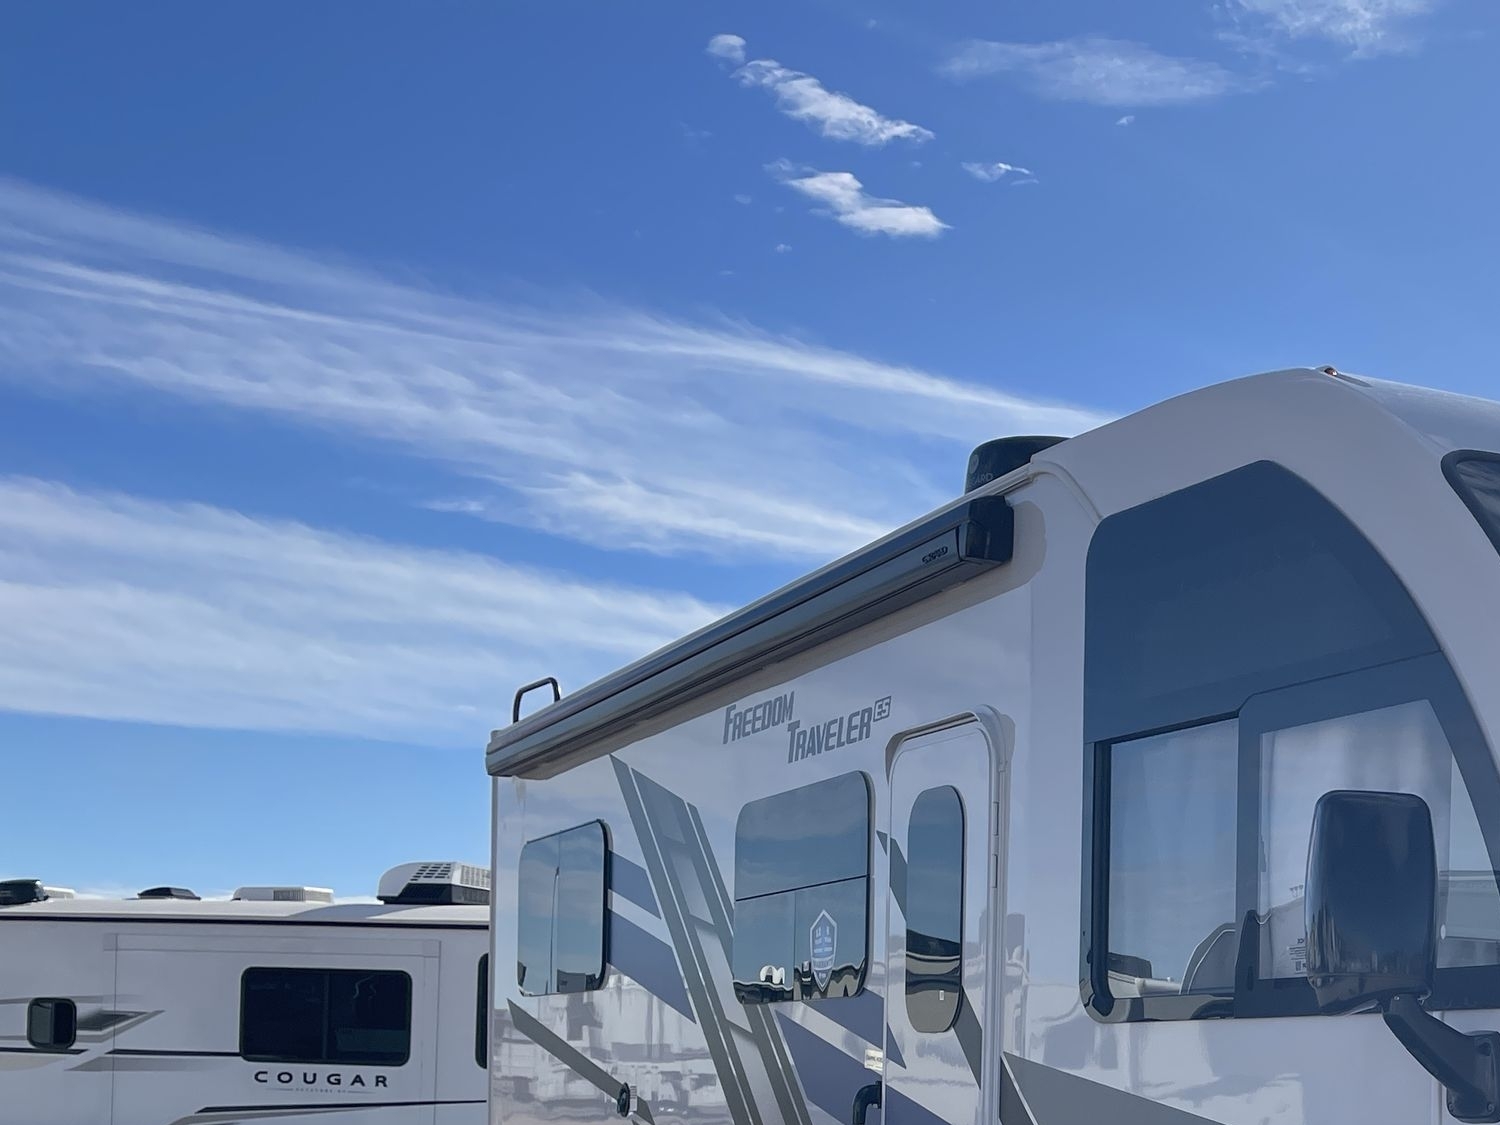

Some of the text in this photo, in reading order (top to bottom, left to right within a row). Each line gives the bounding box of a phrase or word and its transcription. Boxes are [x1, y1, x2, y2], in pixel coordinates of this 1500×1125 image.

[723, 691, 795, 745] FREEDOM
[787, 706, 873, 764] TRAVELER
[254, 1071, 388, 1088] COUGAR
